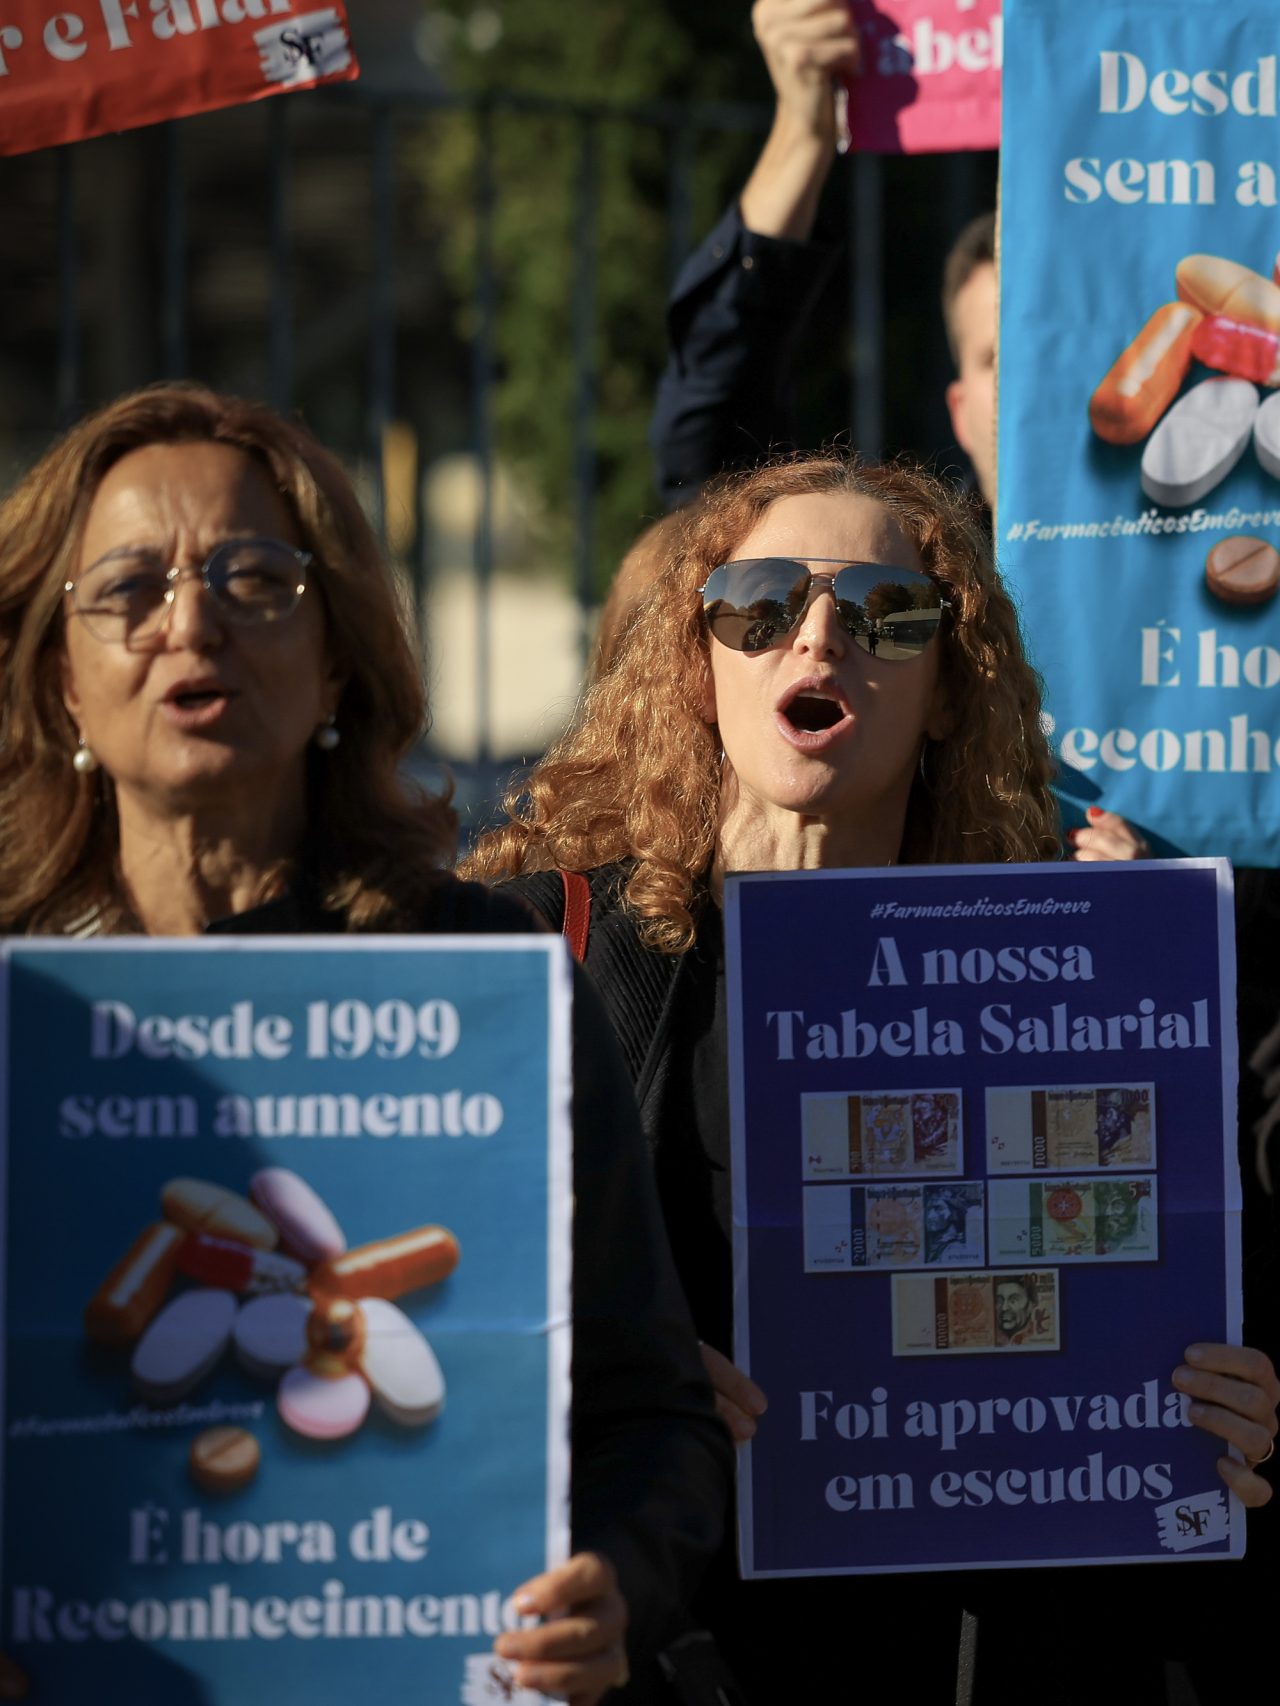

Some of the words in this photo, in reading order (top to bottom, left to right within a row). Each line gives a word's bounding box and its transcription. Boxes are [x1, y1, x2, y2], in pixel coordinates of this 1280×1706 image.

[43, 13, 87, 61] e
[860, 14, 1002, 75] abel
[1064, 158, 1216, 206] sem
[1140, 620, 1181, 687] É
[870, 898, 1091, 920] #FarmacêuticosEmGreve
[867, 937, 908, 987] A
[921, 943, 1095, 985] nossa
[90, 1000, 292, 1060] Desde
[306, 999, 461, 1060] 1999
[766, 1007, 965, 1060] Tabela
[980, 998, 1210, 1056] Salarial
[60, 1094, 197, 1138] sem
[213, 1090, 504, 1138] aumento
[800, 1387, 889, 1440] Foi
[904, 1379, 1193, 1451] aprovada
[825, 1471, 915, 1513] em
[930, 1452, 1174, 1507] escudos
[129, 1500, 169, 1564] É
[182, 1510, 335, 1563] hora
[349, 1507, 429, 1561] de
